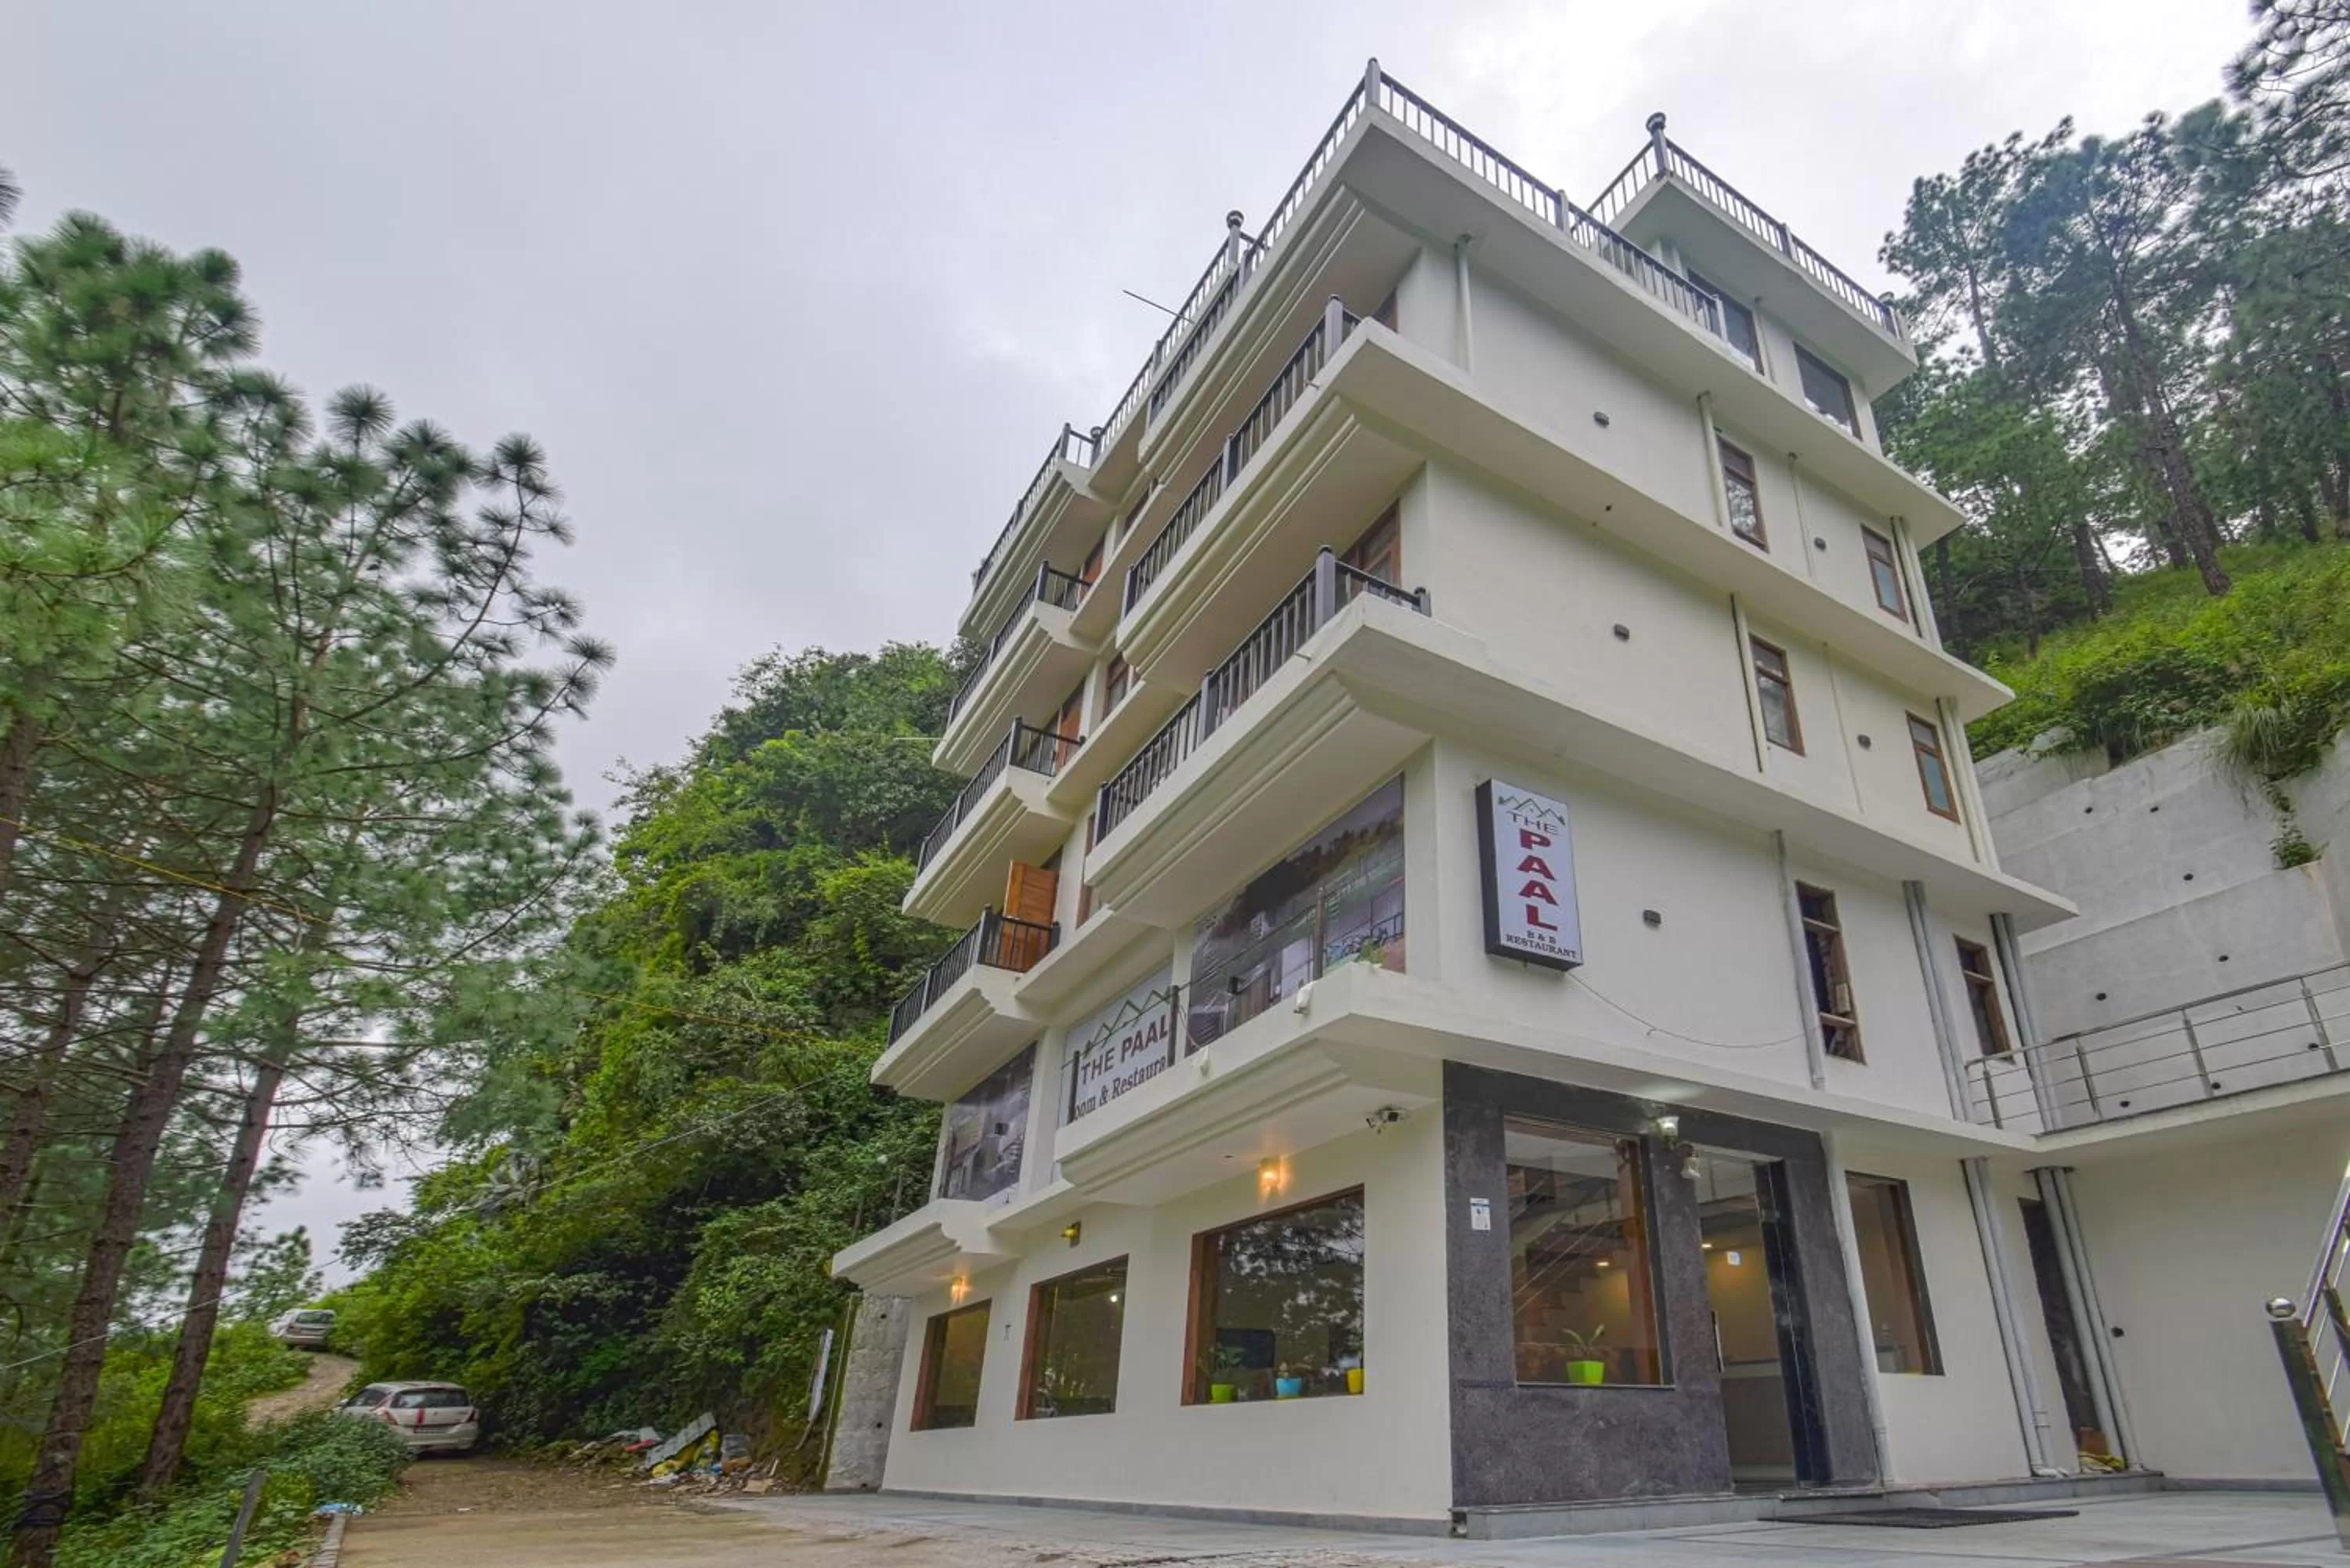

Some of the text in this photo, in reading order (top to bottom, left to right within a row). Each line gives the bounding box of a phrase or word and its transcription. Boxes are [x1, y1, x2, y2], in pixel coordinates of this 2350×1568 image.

[1506, 811, 1559, 836] THE
[1517, 828, 1559, 931] PAAL
[1506, 933, 1577, 959] RESTAURANT
[1081, 1015, 1168, 1085] THE PAAL
[1074, 1056, 1166, 1121] oom & Restaura
